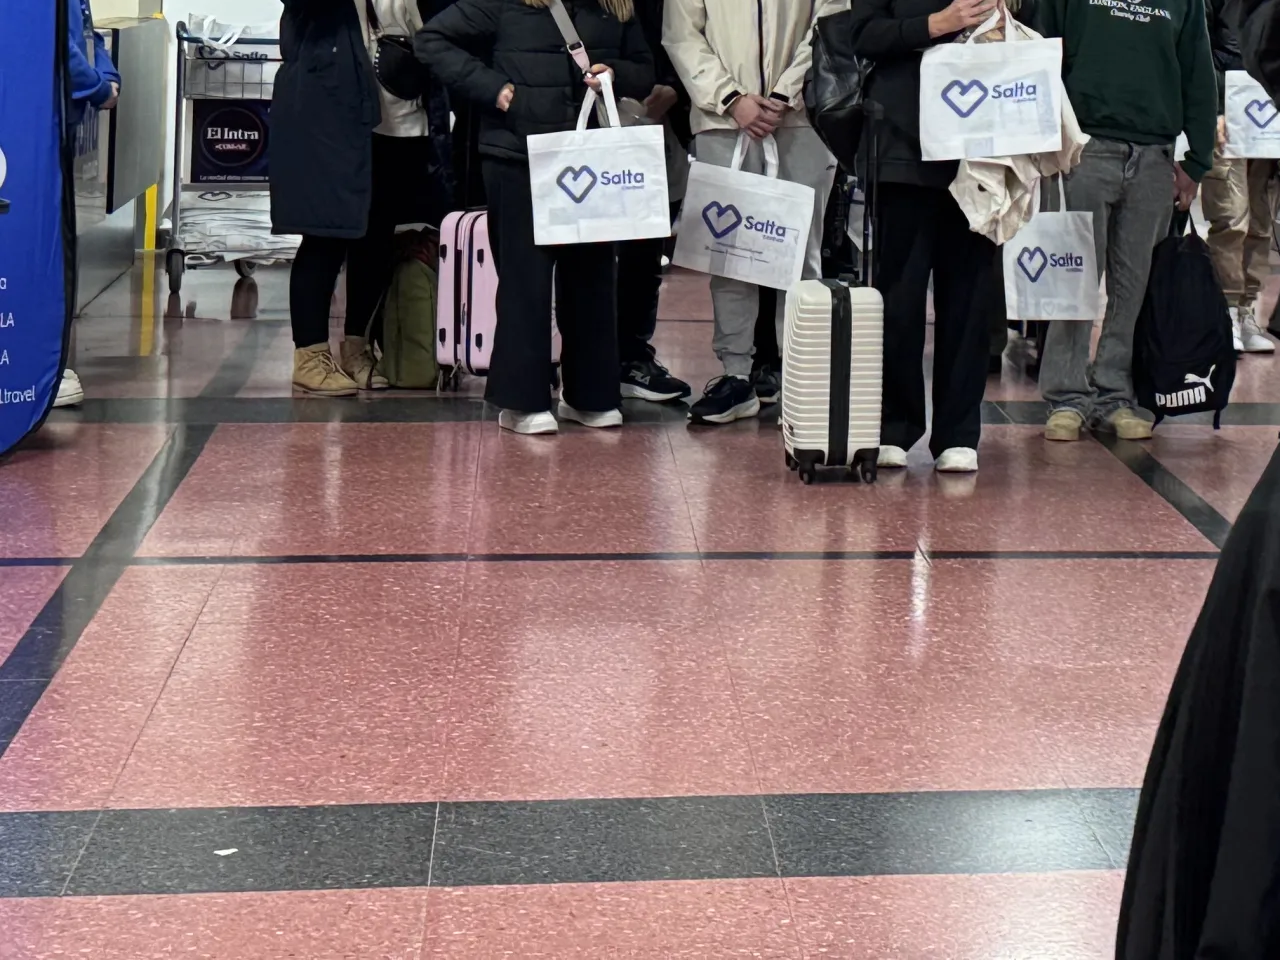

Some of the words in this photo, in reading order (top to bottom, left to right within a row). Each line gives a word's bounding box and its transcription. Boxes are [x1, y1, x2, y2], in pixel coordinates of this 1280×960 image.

[991, 82, 1037, 99] Salta
[207, 127, 221, 139] El
[223, 127, 259, 140] Intra
[600, 169, 645, 186] Salta
[743, 215, 787, 238] Salta
[1049, 252, 1083, 267] Salta
[0, 278, 7, 290] a
[0, 312, 15, 328] LA
[0, 350, 9, 365] A
[1155, 385, 1206, 407] PUMA
